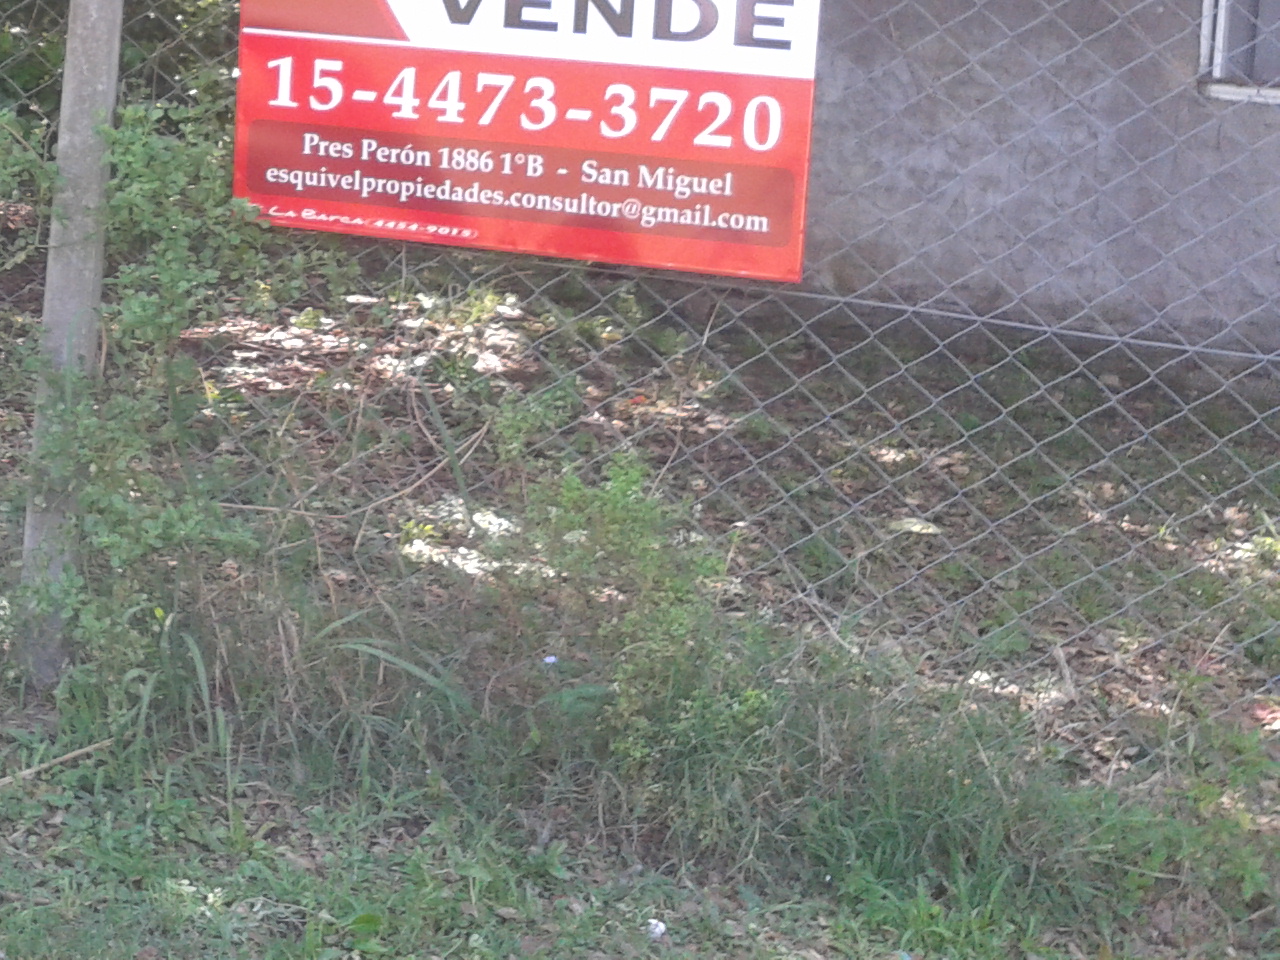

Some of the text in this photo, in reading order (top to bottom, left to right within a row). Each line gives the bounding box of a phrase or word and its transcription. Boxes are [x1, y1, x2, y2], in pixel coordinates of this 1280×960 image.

[265, 55, 784, 152] 15-4473-3720
[265, 166, 769, 233] esquivelpropiedades.consultor@gmail.com
[301, 132, 354, 159] Pres
[360, 137, 432, 167] Perón
[438, 147, 494, 173] 1886
[581, 159, 630, 187] San
[637, 164, 734, 200] Miguel
